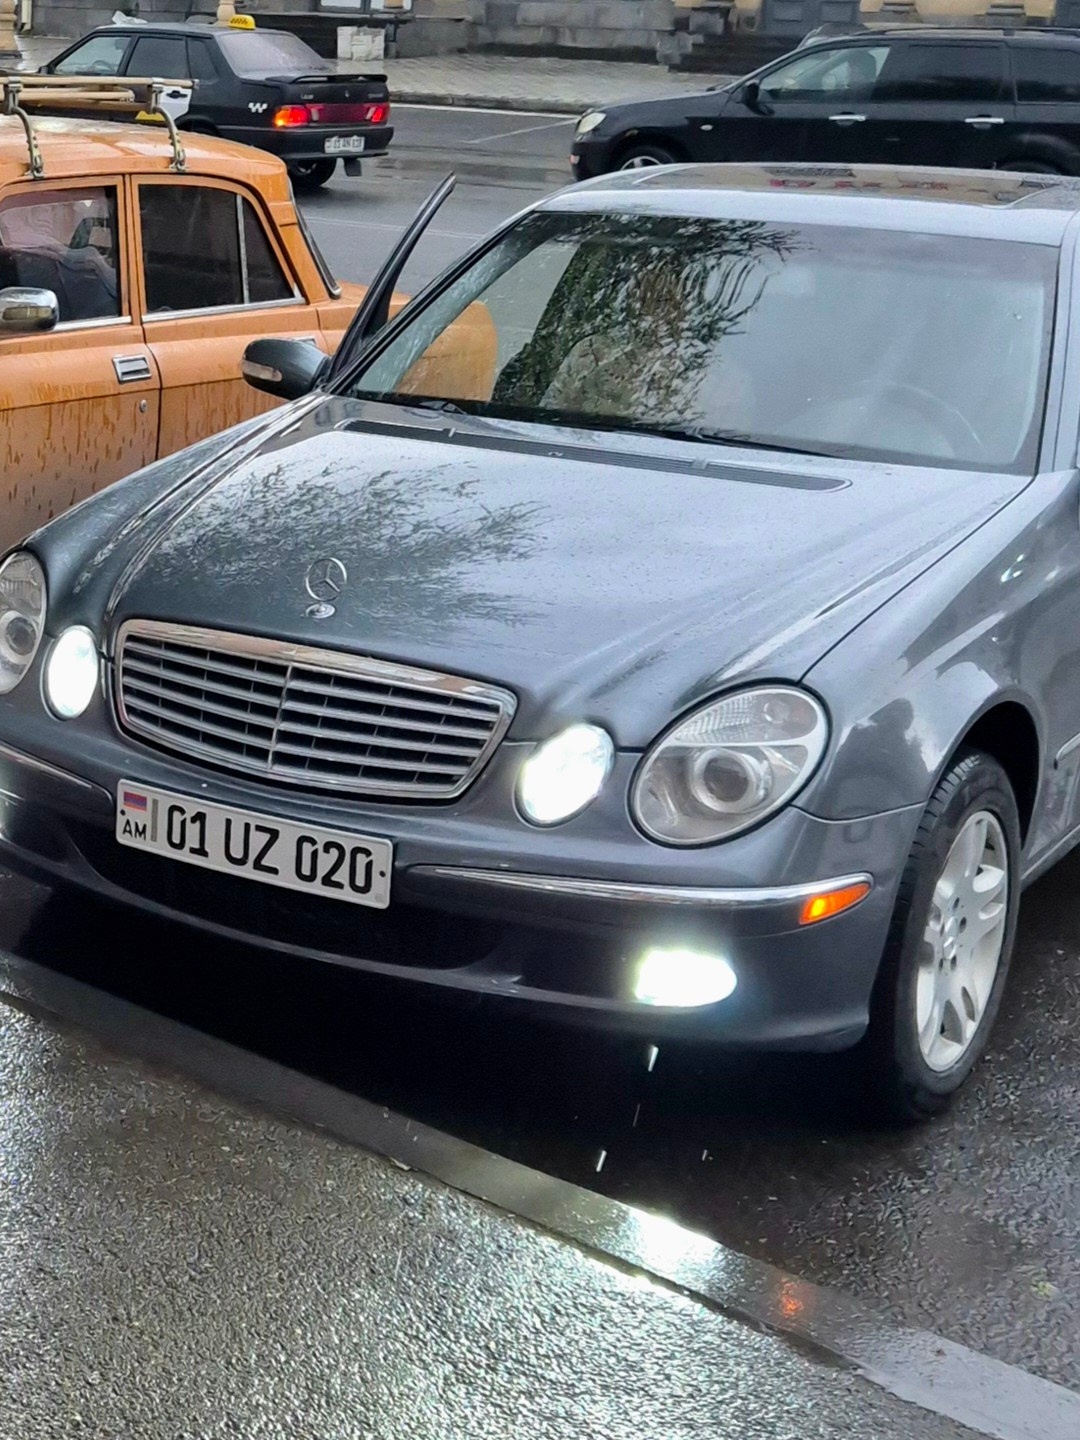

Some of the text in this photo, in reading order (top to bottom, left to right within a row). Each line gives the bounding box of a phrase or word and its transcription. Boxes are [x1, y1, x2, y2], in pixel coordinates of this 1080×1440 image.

[122, 818, 147, 841] AM
[166, 804, 373, 895] 01 UZ 020
